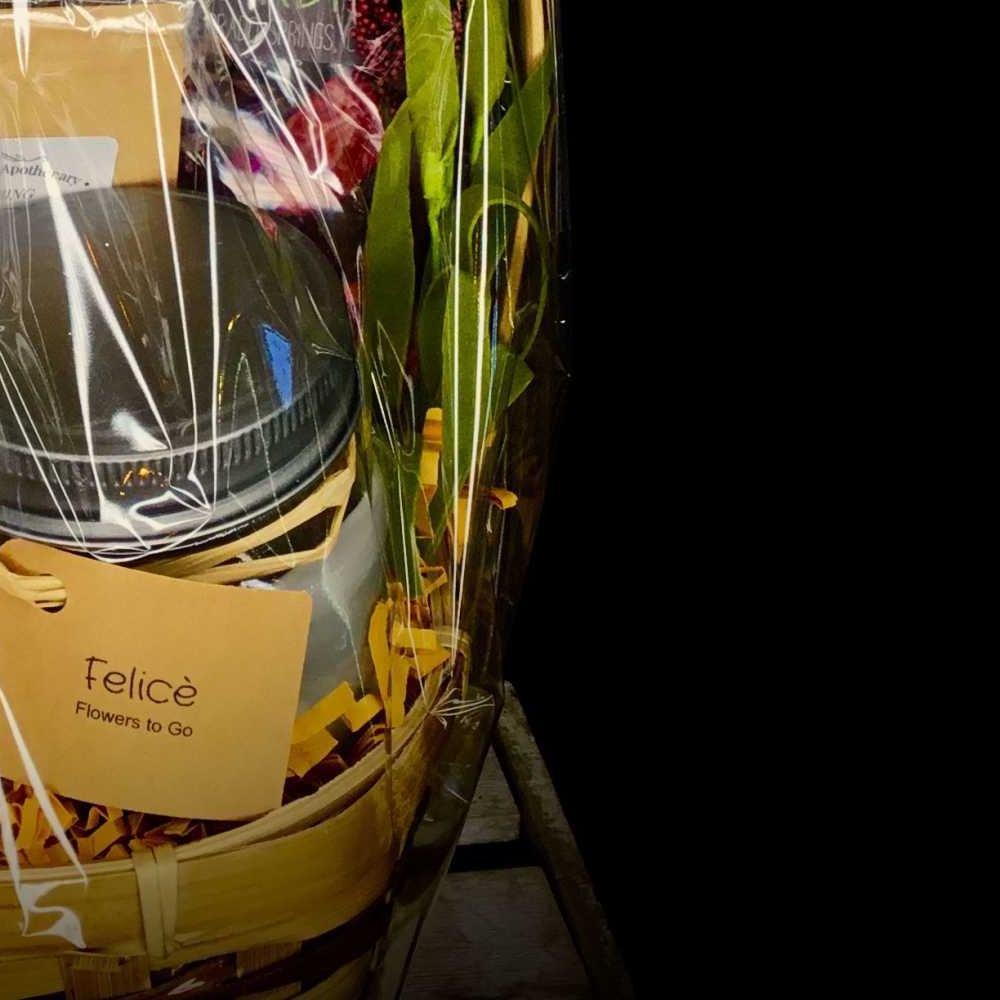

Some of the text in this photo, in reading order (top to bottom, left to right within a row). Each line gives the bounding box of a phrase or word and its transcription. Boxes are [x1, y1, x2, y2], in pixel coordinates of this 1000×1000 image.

[85, 656, 198, 707] Felicè
[75, 700, 193, 737] Flowers to Go
